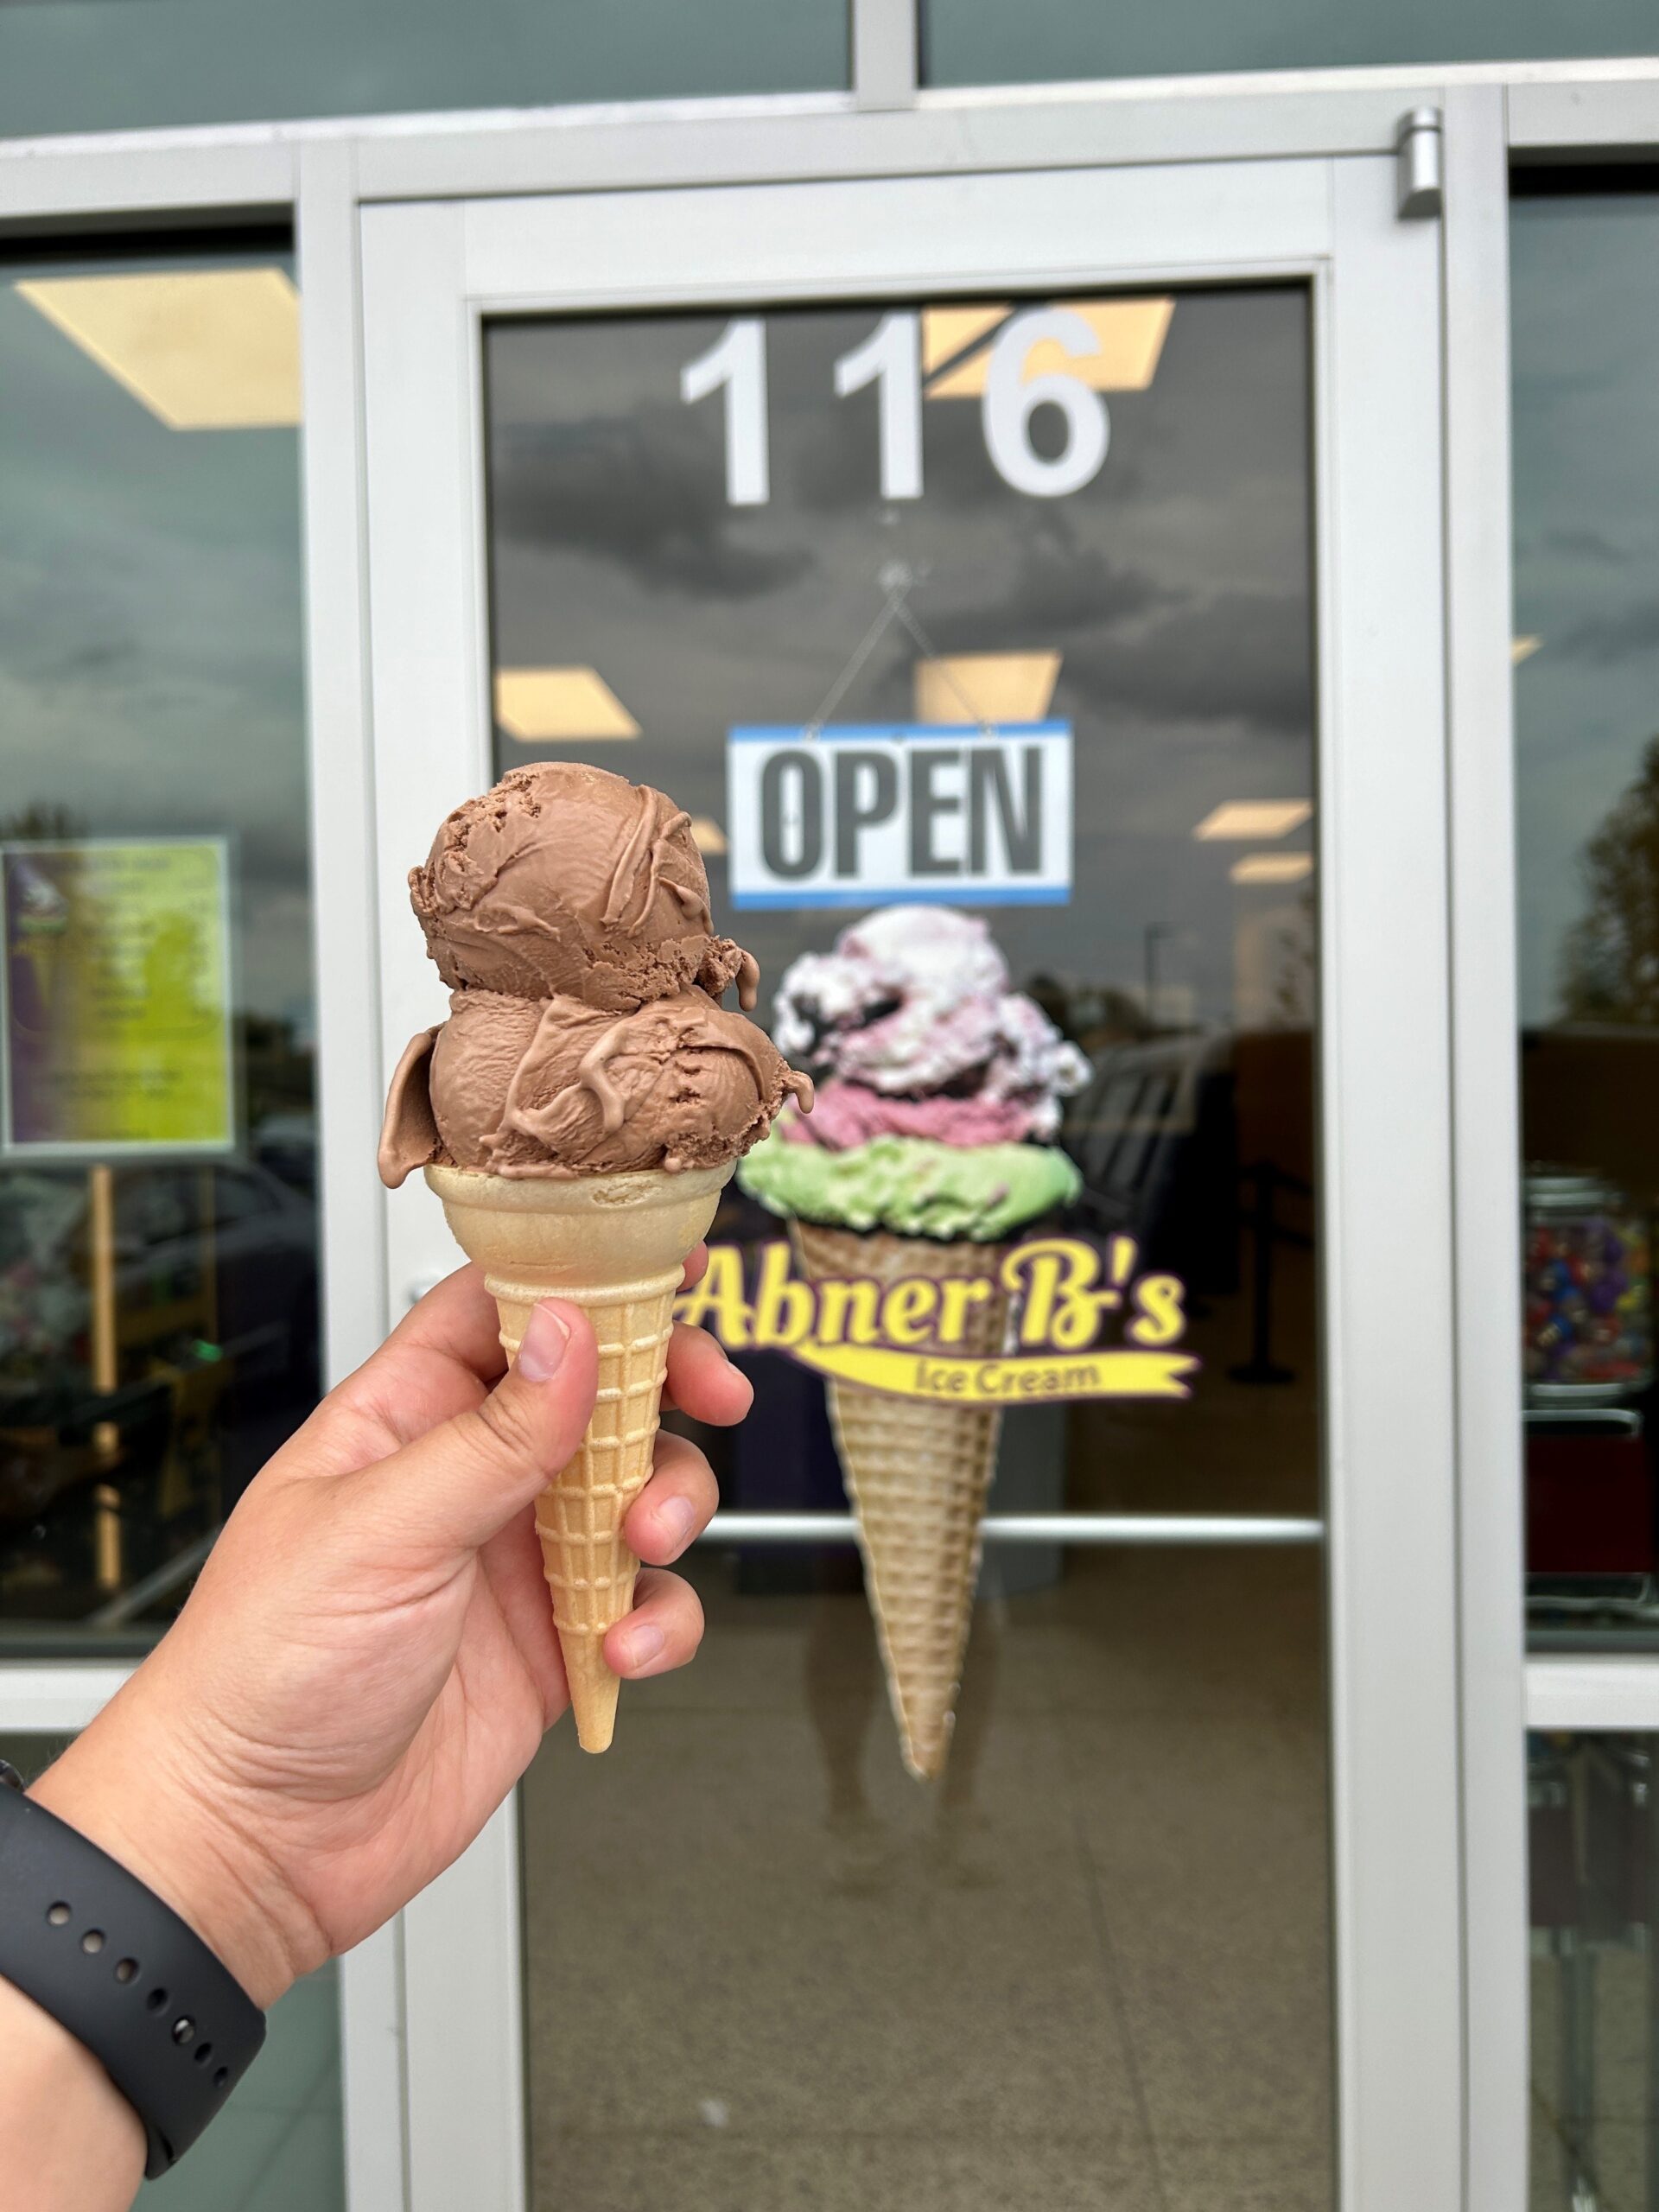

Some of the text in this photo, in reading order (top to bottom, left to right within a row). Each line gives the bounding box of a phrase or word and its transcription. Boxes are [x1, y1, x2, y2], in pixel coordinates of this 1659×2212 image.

[680, 309, 1111, 505] 116
[761, 747, 1043, 879] OPEN
[675, 1236, 1187, 1351] Abner B's
[916, 1358, 1102, 1395] Ice Cream
